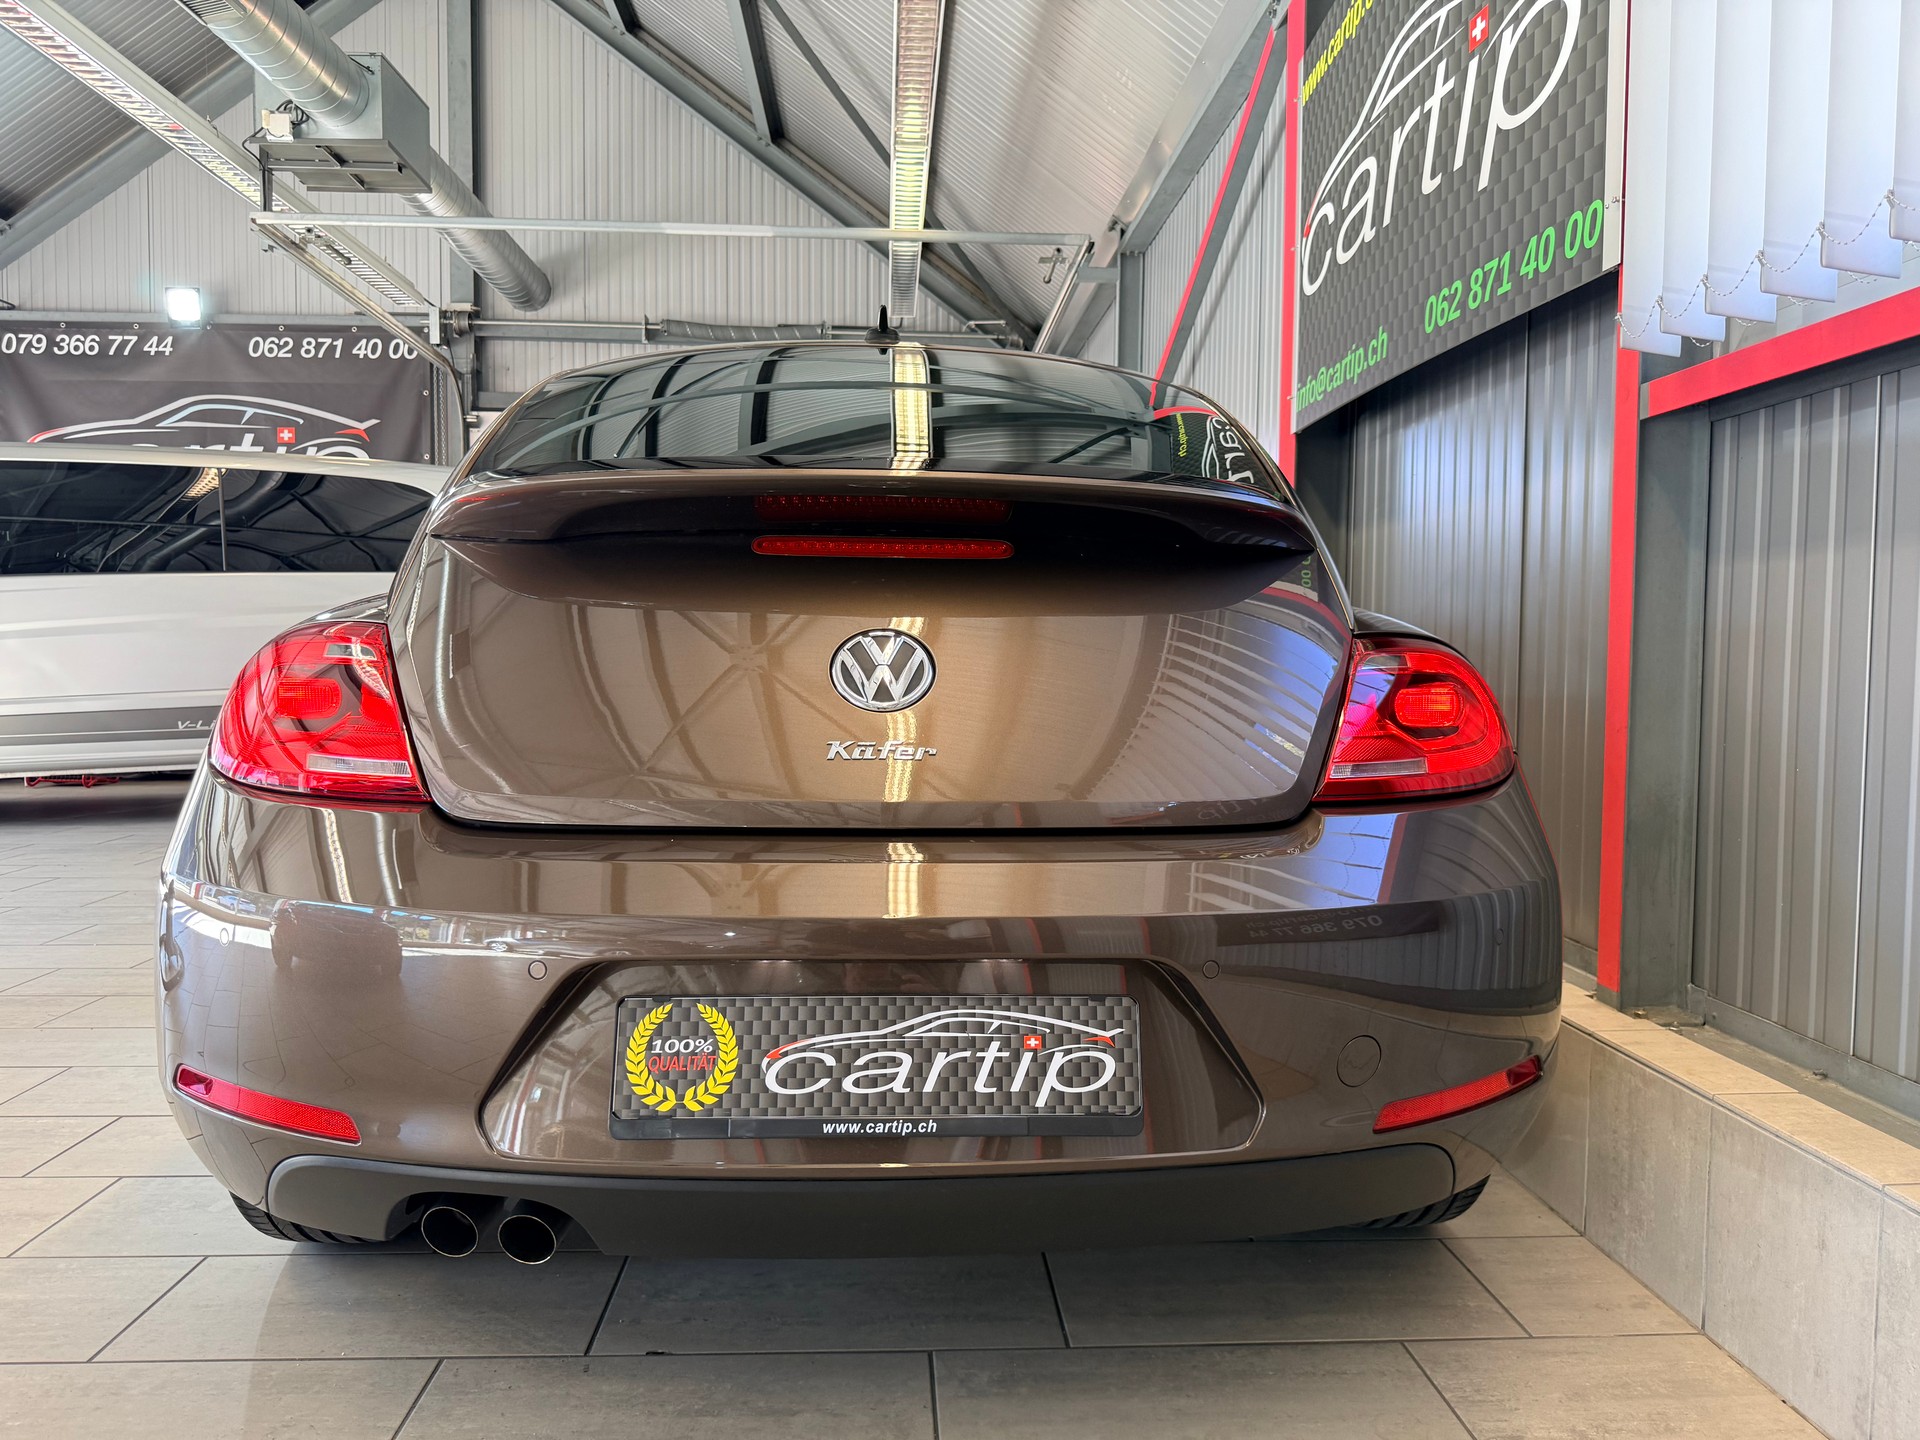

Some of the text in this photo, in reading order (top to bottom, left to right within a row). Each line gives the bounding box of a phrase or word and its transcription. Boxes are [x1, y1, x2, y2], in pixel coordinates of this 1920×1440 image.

[1302, 0, 1582, 296] cartip
[1424, 199, 1604, 334] 062 871 40 00
[1, 333, 174, 356] 079 366 77 44
[248, 336, 294, 358] 062
[300, 338, 344, 359] 871
[352, 338, 383, 359] 40
[1296, 326, 1388, 413] info@cartip.ch
[651, 1038, 714, 1053] 100%
[648, 1053, 717, 1074] QUALITÄT
[762, 1040, 1117, 1107] cartip
[822, 1119, 938, 1136] www.cartip.ch
